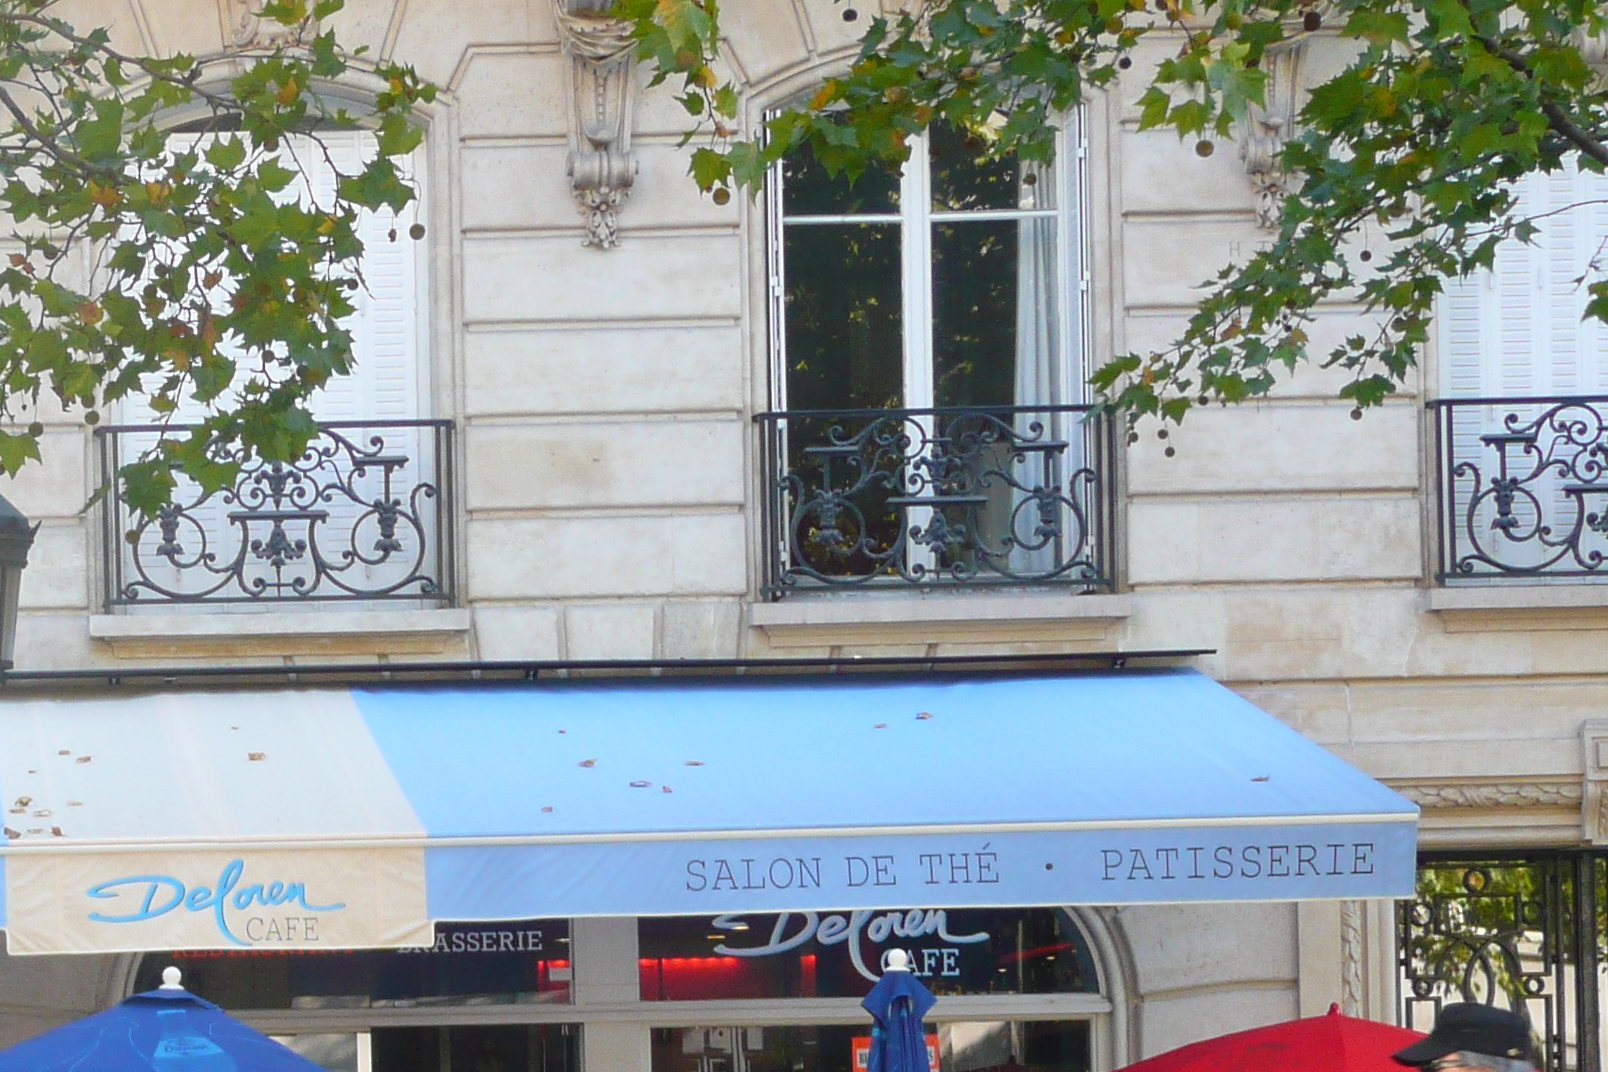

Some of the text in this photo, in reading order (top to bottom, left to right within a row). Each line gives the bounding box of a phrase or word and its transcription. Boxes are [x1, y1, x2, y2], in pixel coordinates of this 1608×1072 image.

[685, 841, 1000, 892] SALON DE THÉ
[1100, 842, 1376, 882] PATISSERIE
[86, 858, 346, 947] Deloren
[245, 916, 320, 942] CAFE
[396, 930, 543, 954] ASSERIE
